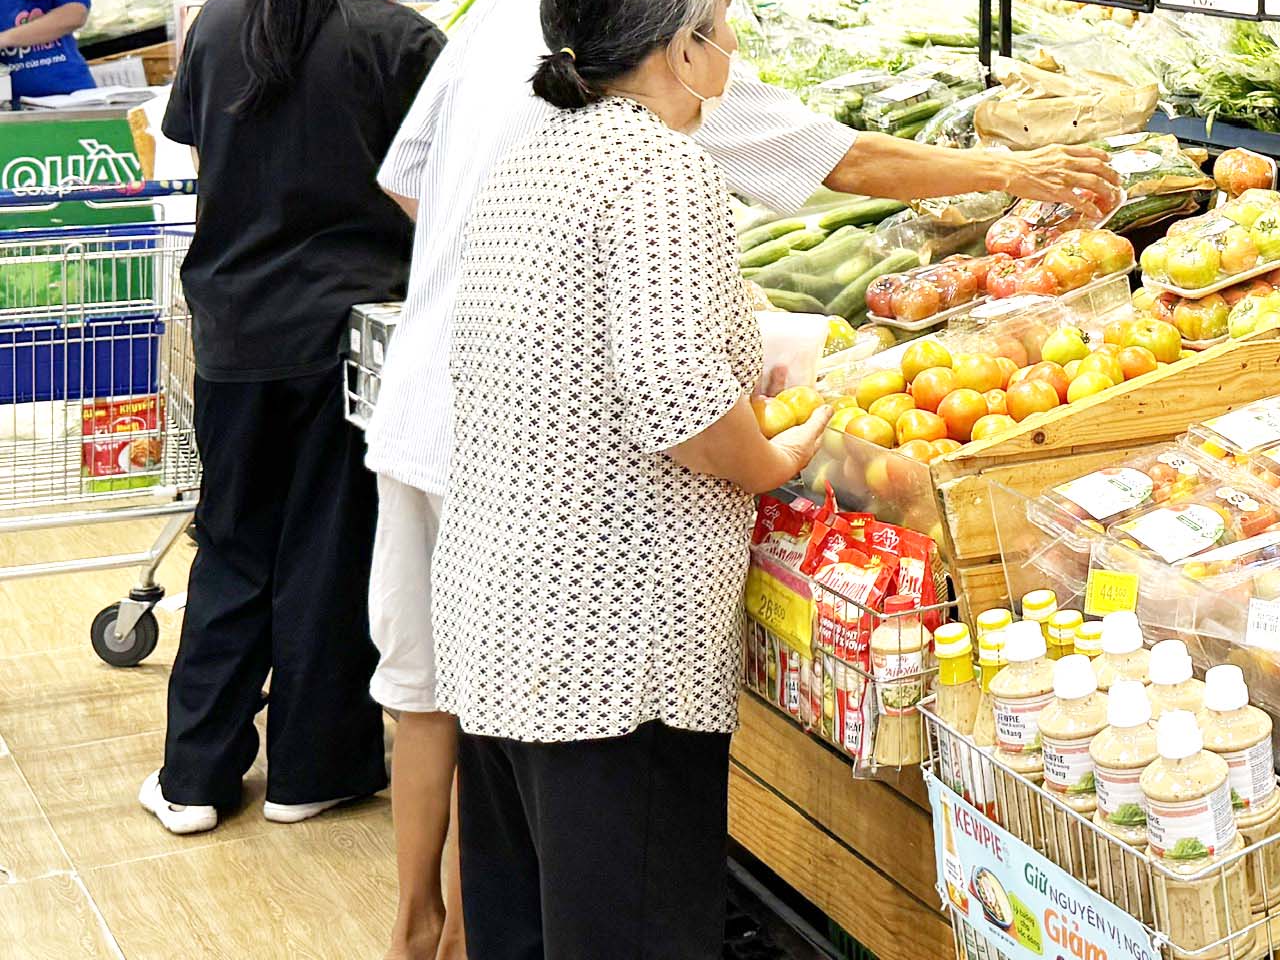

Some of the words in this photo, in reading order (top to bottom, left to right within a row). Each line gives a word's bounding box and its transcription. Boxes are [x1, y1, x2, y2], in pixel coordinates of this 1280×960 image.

[954, 802, 1003, 863] KEWPIE
[1024, 862, 1048, 896] Giữ
[1049, 887, 1106, 934] NGUYÊN
[1107, 921, 1121, 950] VỊ
